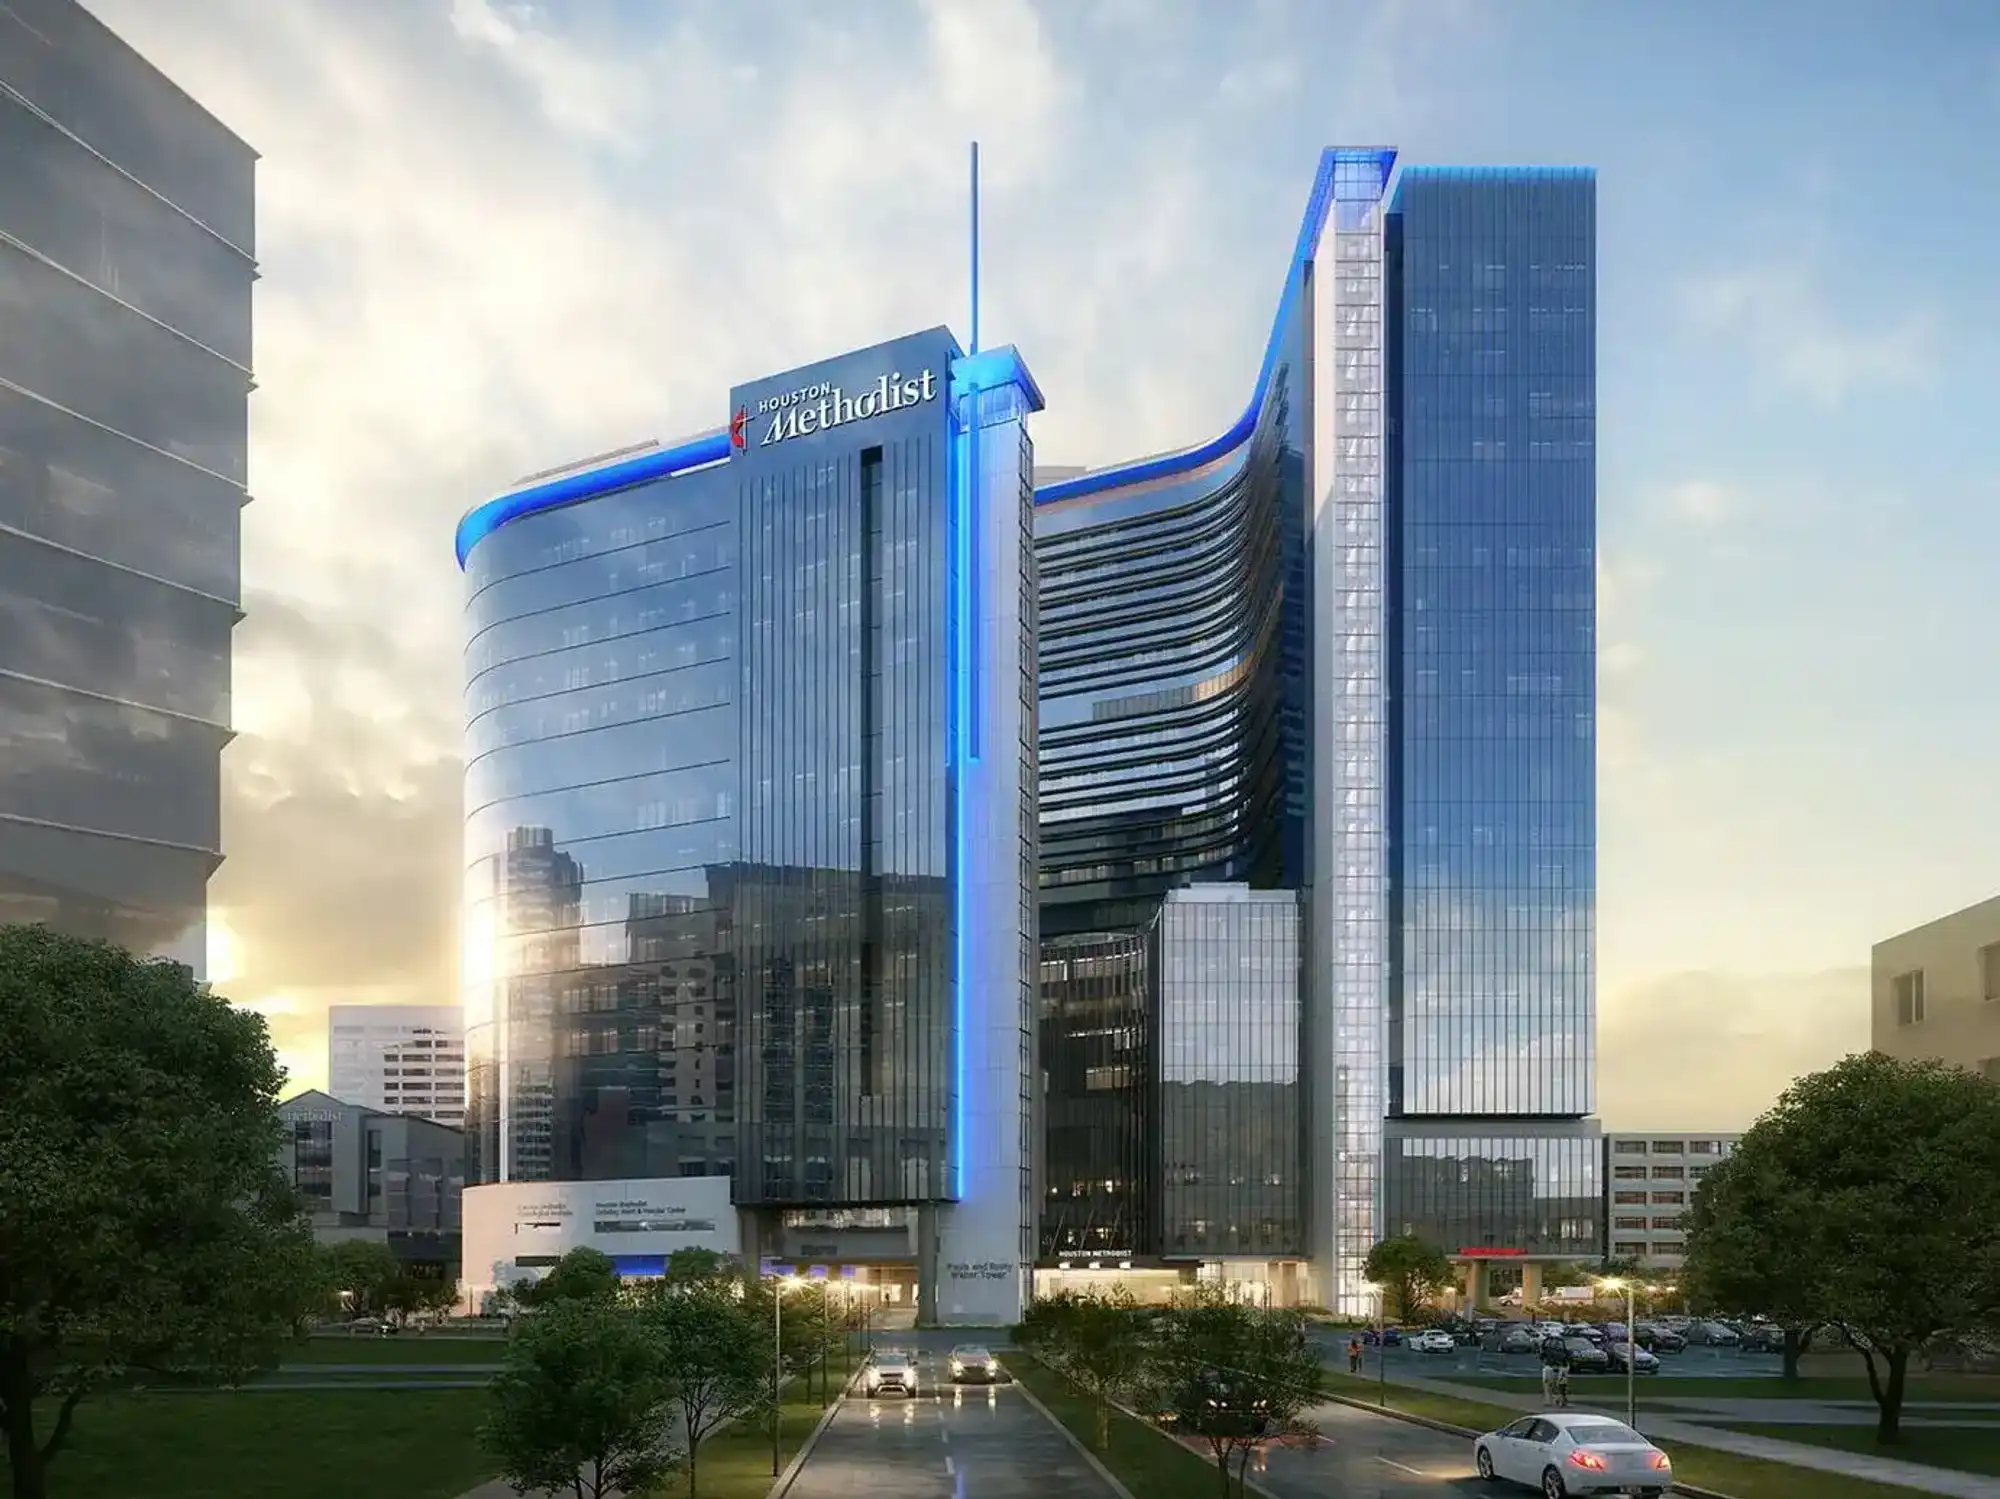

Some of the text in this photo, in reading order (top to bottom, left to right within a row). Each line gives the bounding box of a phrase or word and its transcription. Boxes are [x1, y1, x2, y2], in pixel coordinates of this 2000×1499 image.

[759, 382, 833, 414] HOUSTON
[760, 368, 938, 447] Methodist
[1058, 1249, 1132, 1258] HOUSTON METHODIST
